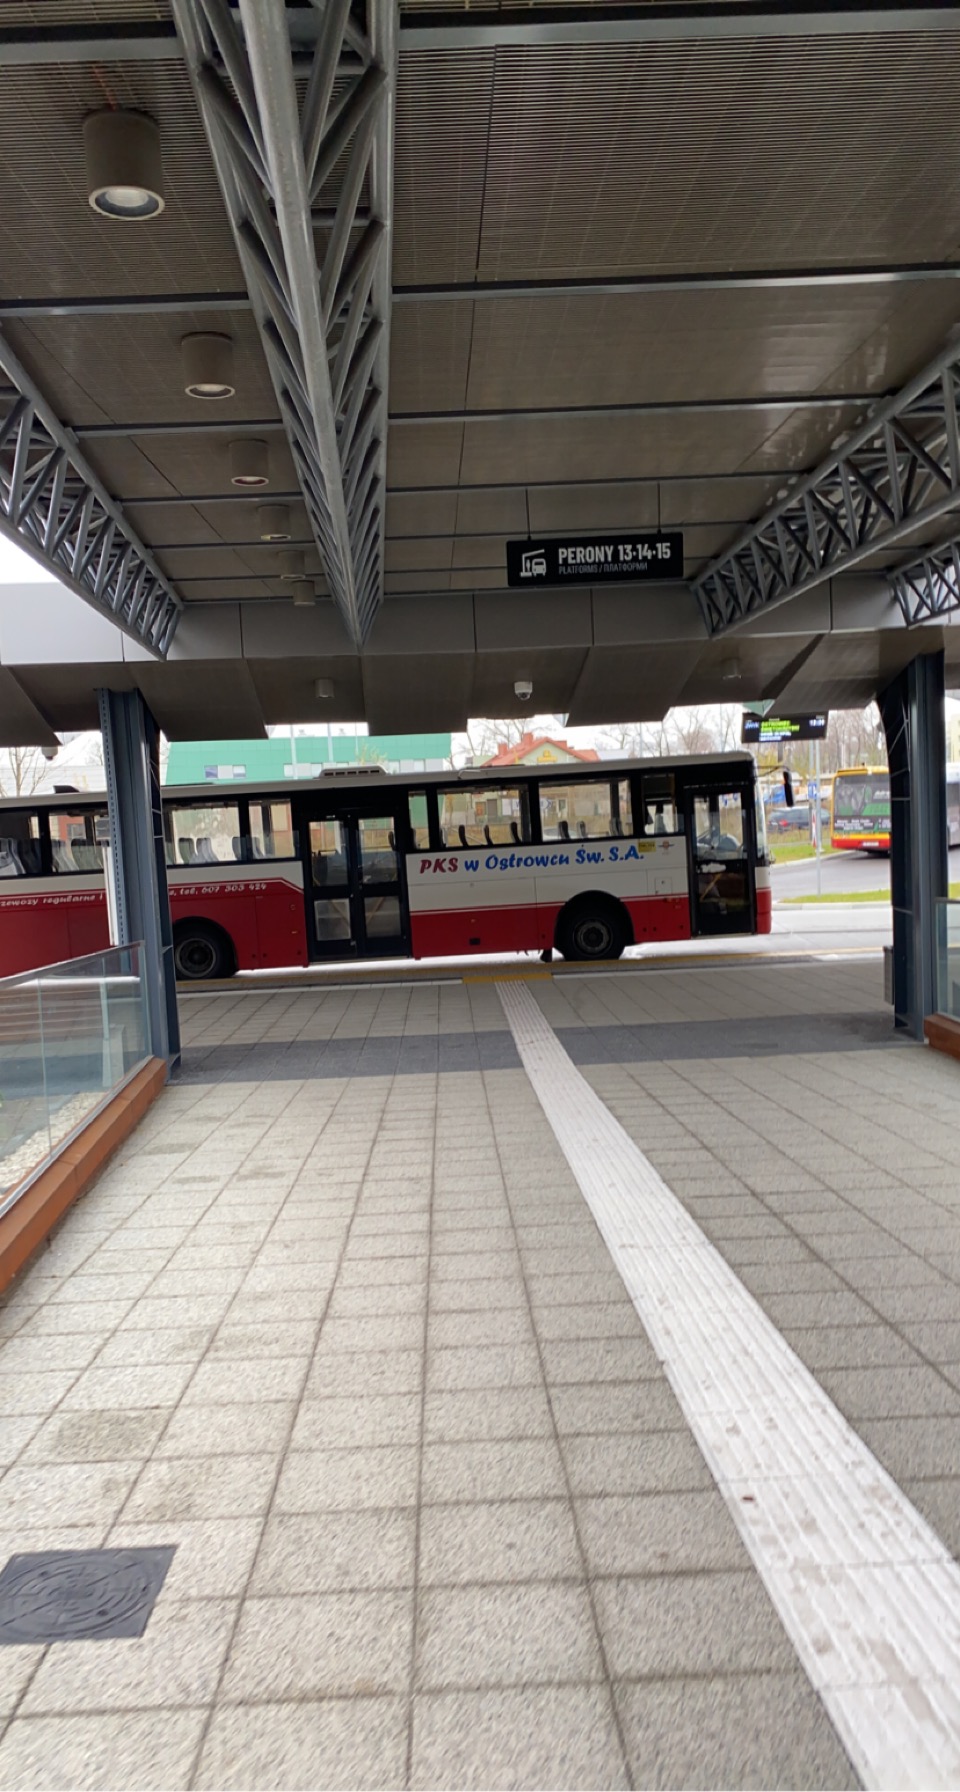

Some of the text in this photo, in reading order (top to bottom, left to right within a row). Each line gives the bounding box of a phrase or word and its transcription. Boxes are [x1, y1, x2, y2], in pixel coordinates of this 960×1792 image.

[558, 545, 614, 565] PERONY
[558, 564, 598, 575] PLATFORMS
[603, 562, 648, 573] ПЛАТФОРМИ
[419, 844, 645, 875] PKS w Ostrowcu Św. S.A.
[201, 885, 220, 894] 607
[224, 884, 245, 893] 303
[248, 882, 267, 891] 424
[0, 898, 39, 907] zewozy
